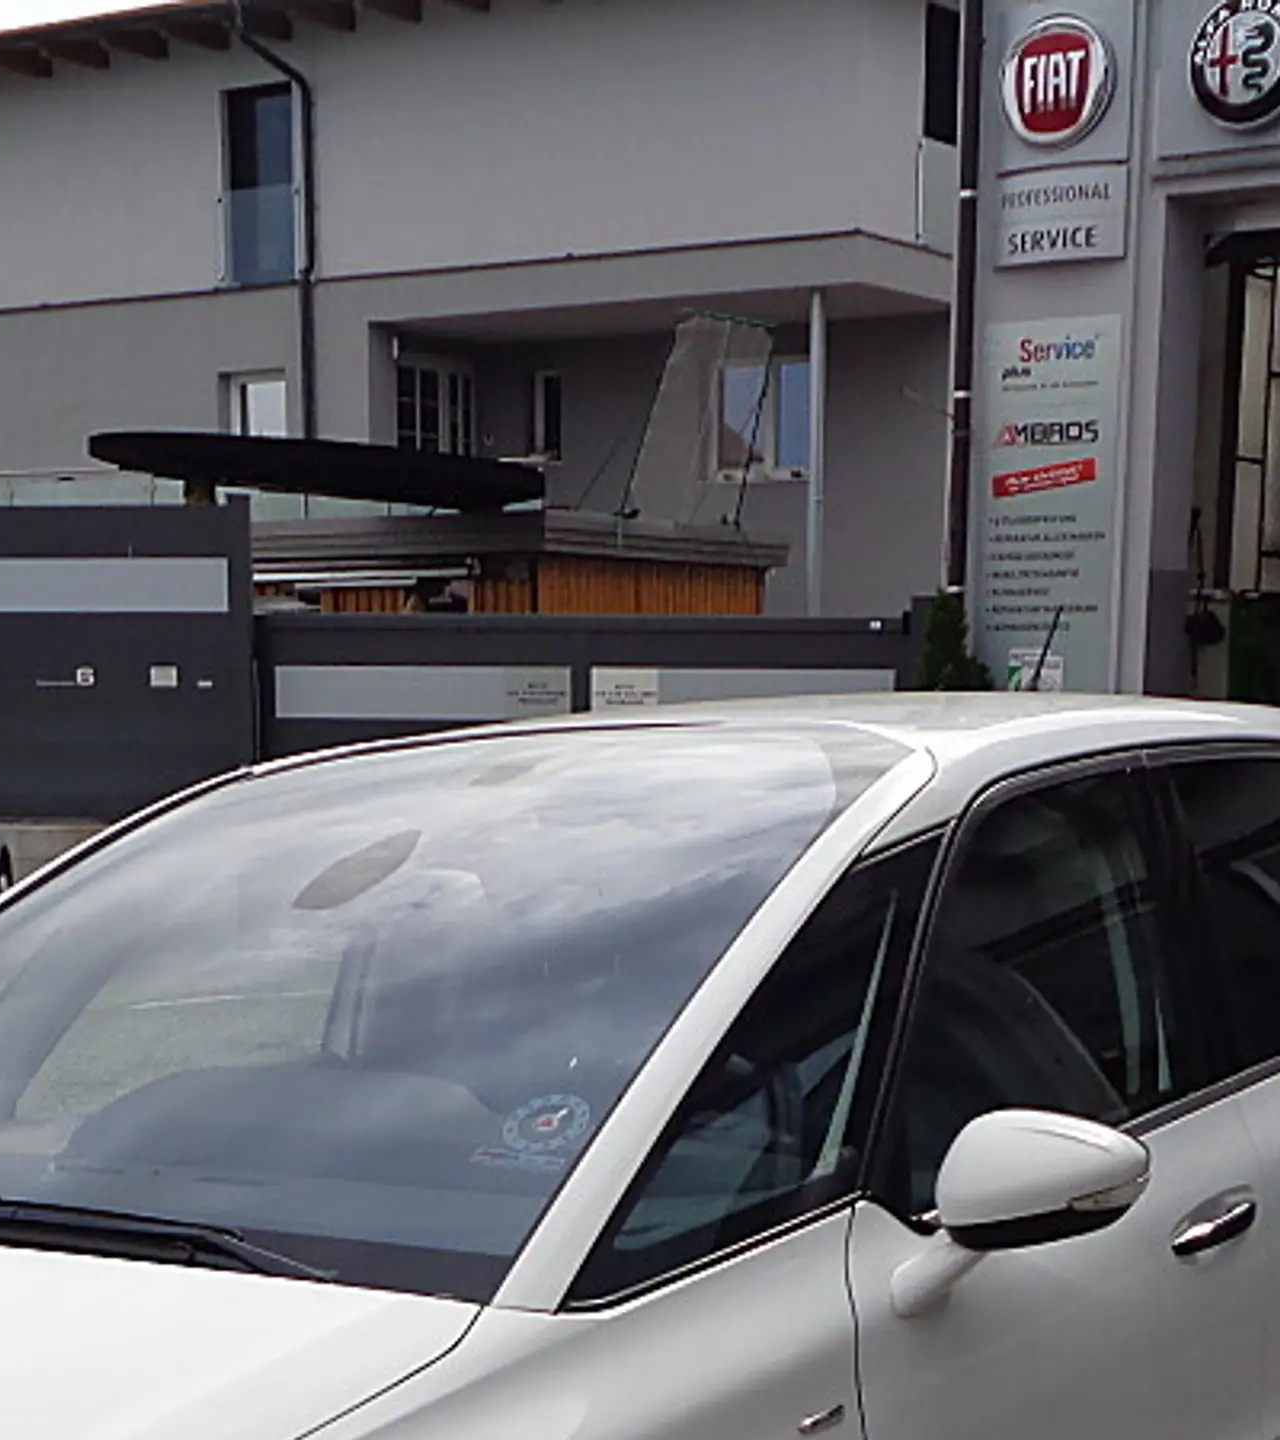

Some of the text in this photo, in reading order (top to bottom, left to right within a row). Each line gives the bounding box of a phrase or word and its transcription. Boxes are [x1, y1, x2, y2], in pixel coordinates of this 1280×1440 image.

[1023, 50, 1087, 115] FIAT
[1008, 225, 1098, 255] SERVICE
[1019, 334, 1095, 364] Service
